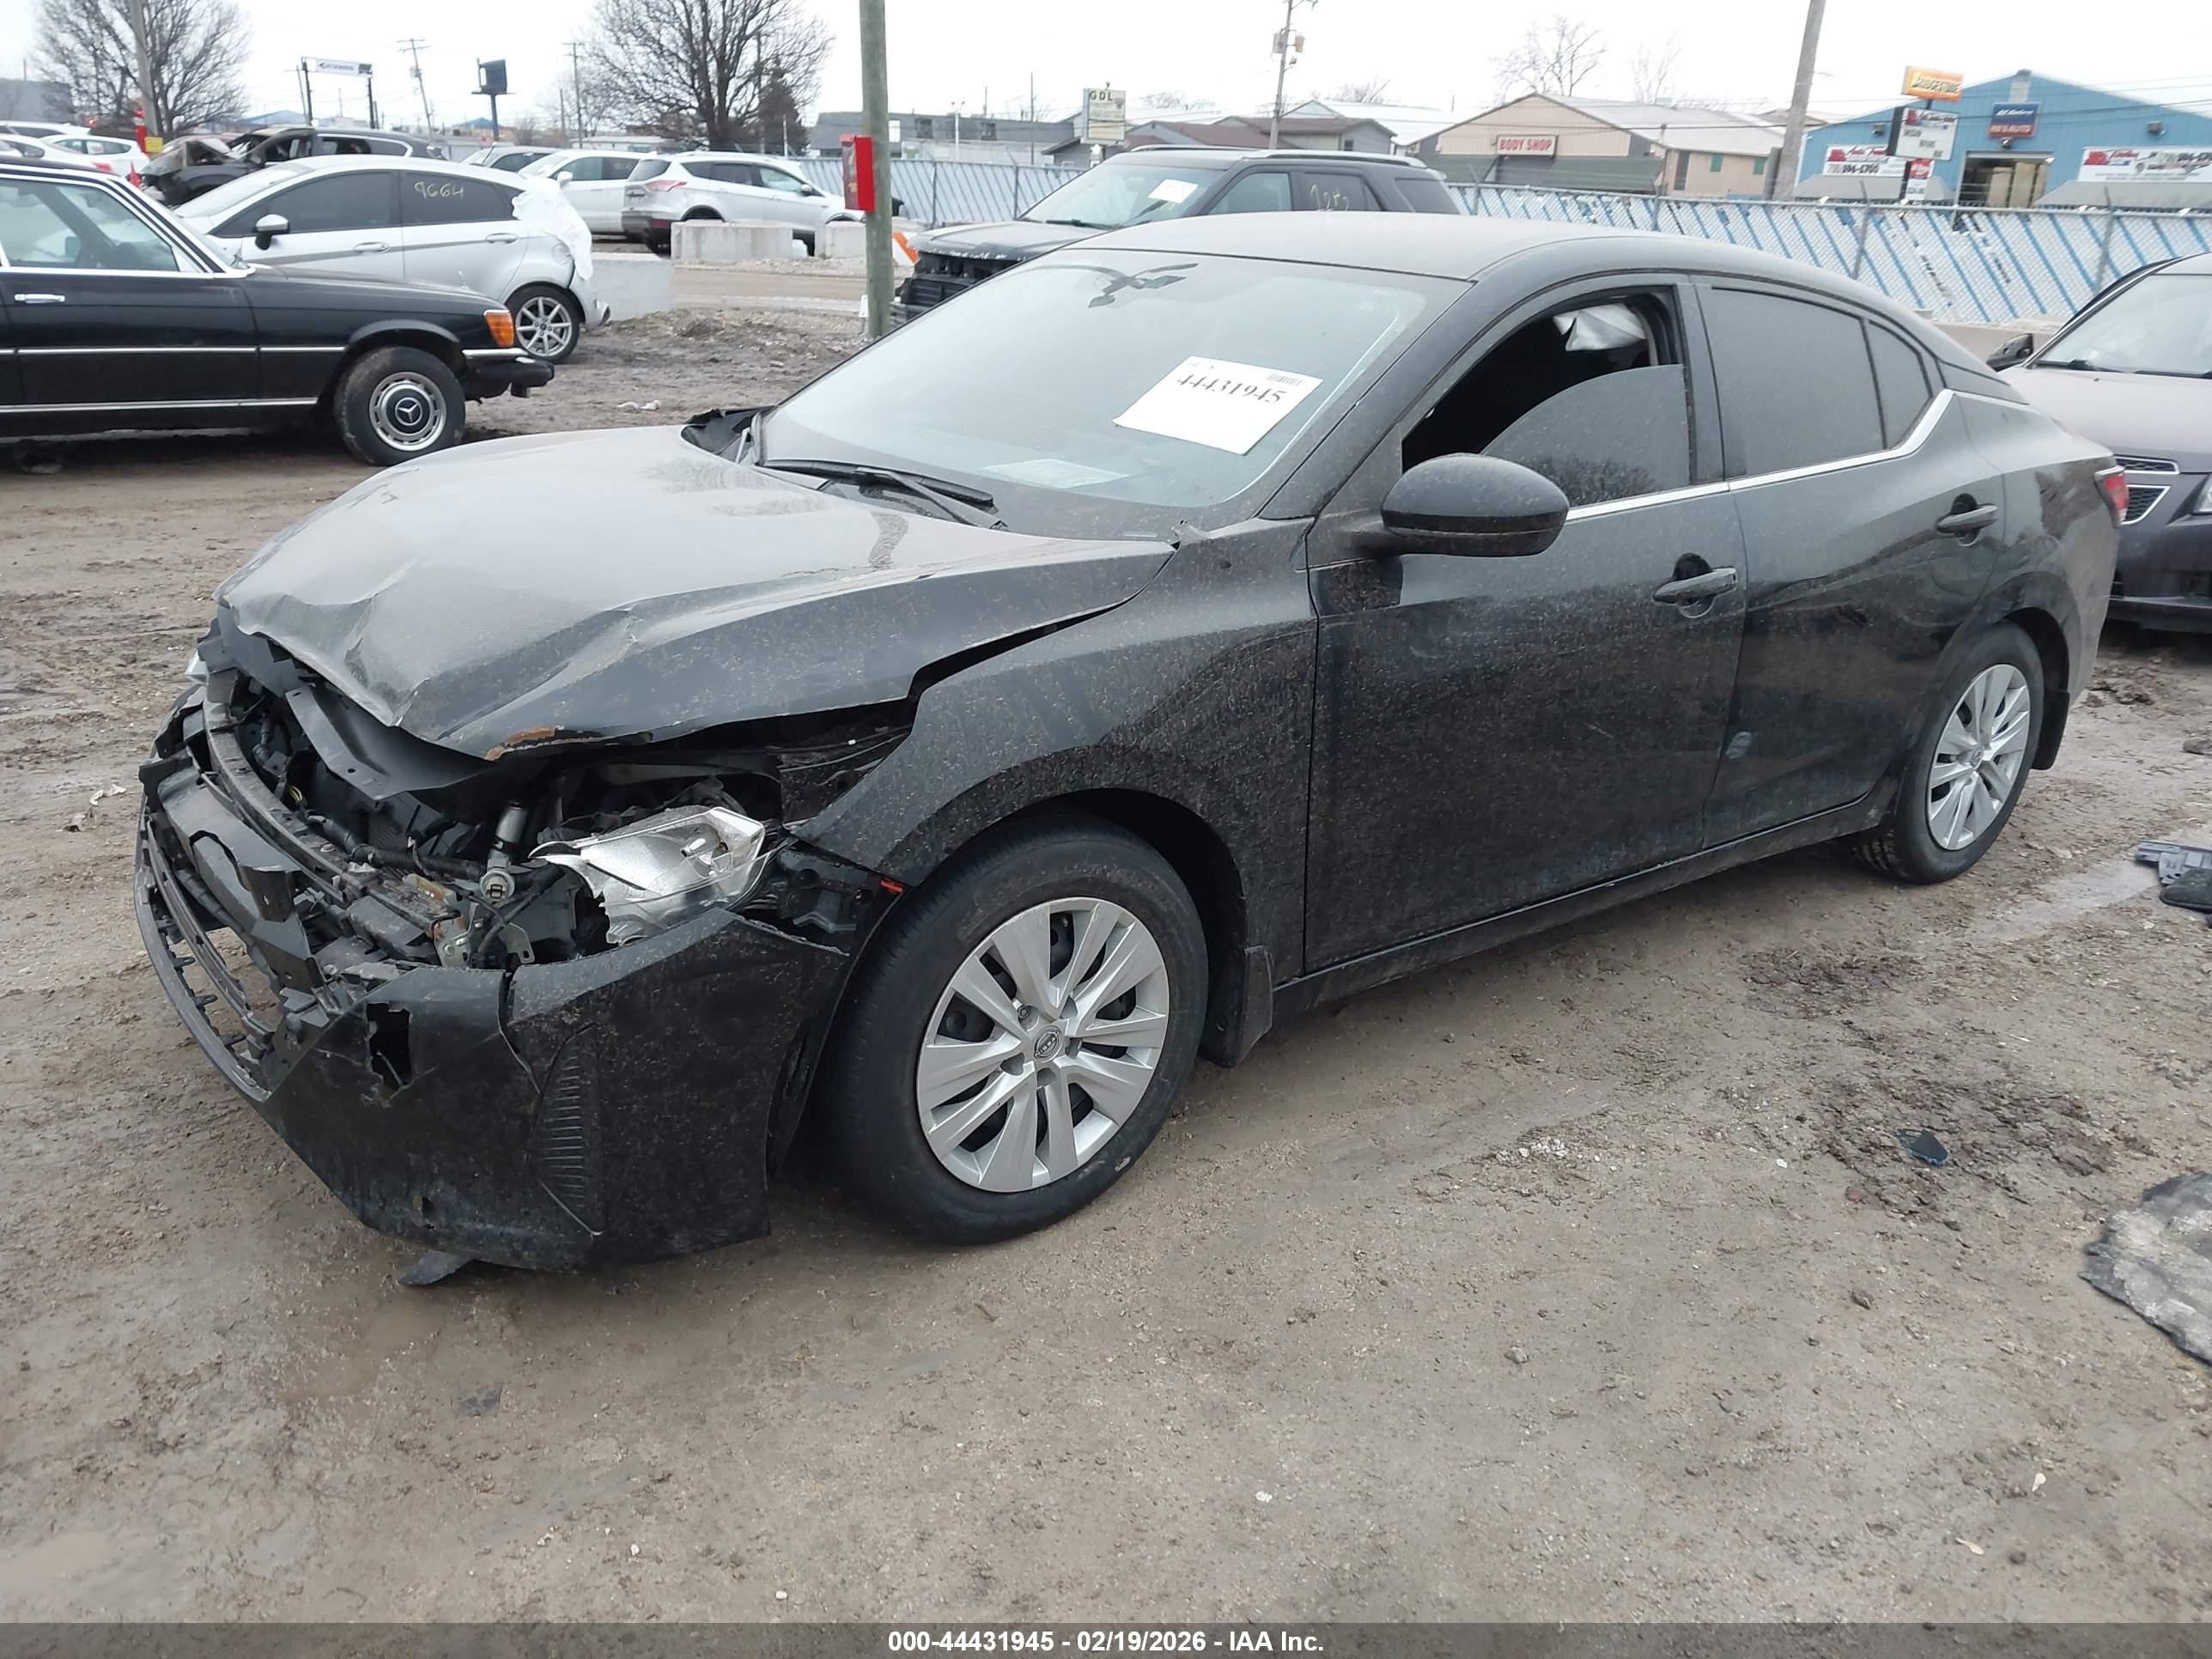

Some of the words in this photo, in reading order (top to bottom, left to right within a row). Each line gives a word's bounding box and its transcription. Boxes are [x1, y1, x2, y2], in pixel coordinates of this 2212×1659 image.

[1499, 138, 1524, 150] BODY
[1526, 138, 1553, 151] SHOP
[414, 180, 465, 200] 9664
[1176, 374, 1287, 403] 44431945
